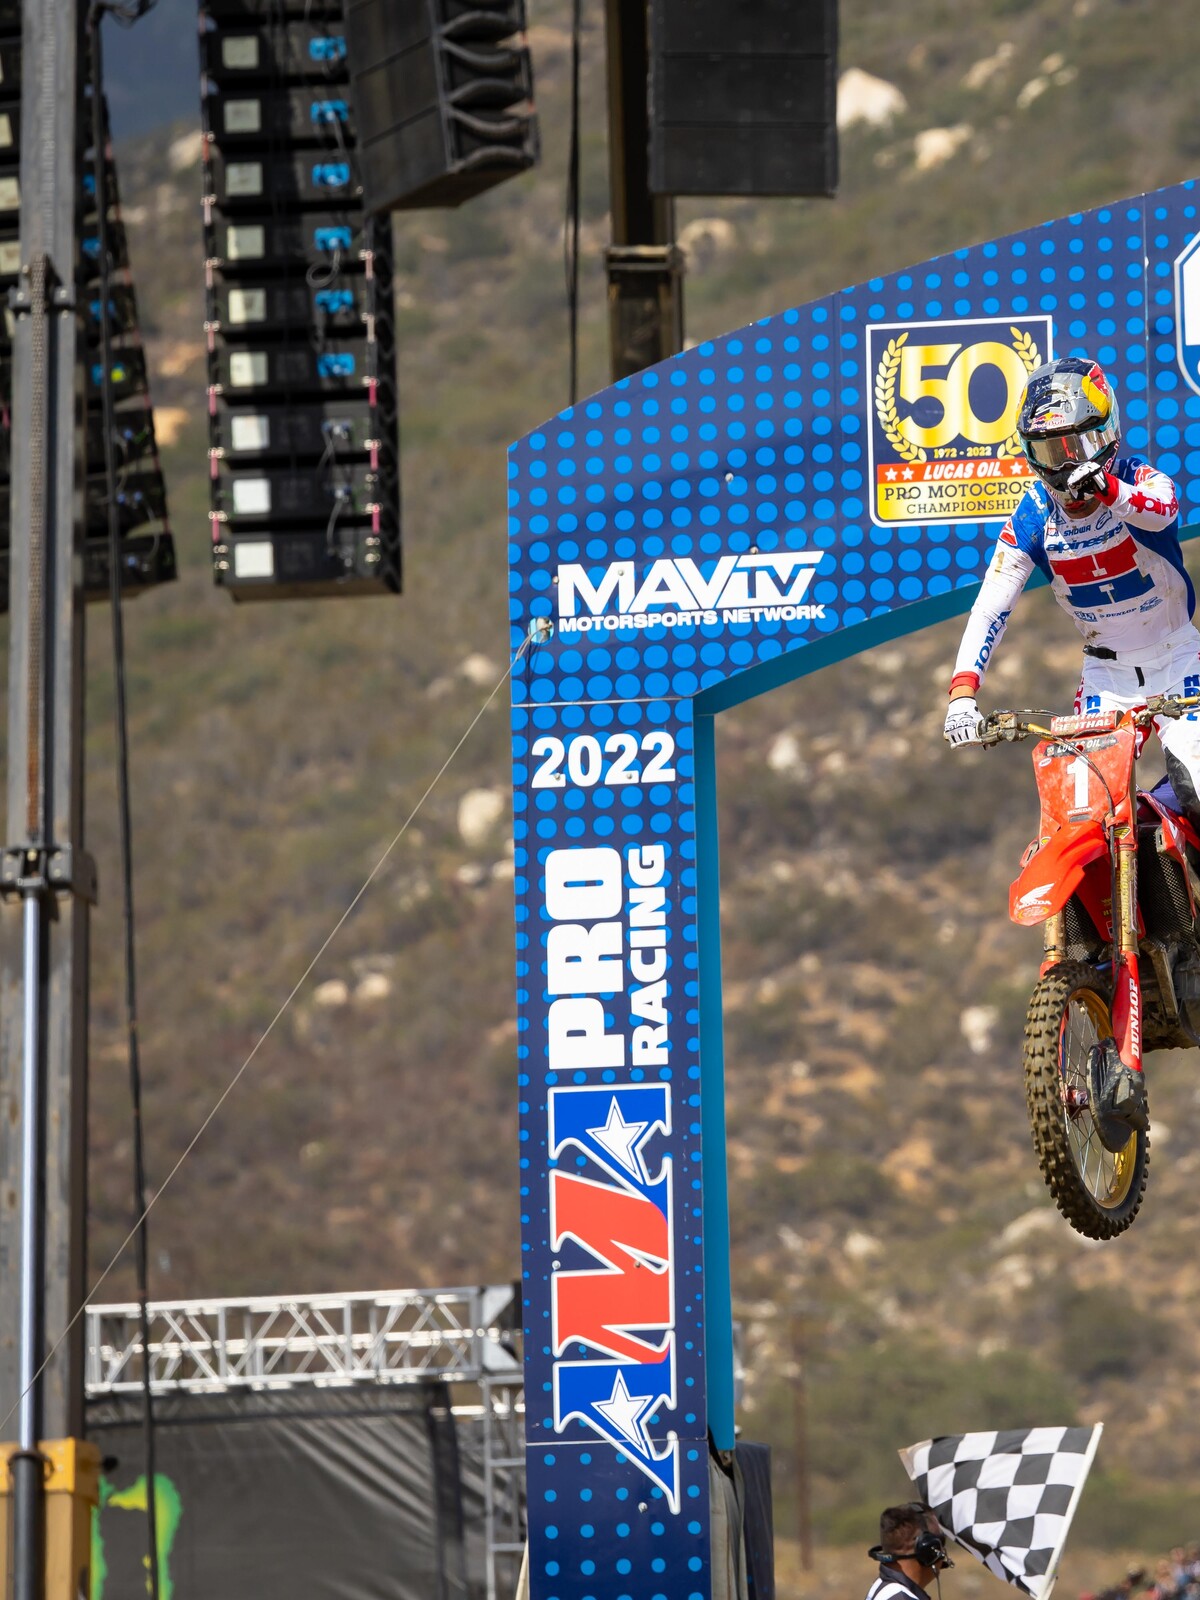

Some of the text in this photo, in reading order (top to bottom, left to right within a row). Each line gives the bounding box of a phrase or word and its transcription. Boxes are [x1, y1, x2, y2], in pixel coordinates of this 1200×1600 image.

[896, 341, 1028, 448] 50
[934, 448, 957, 459] 1972
[967, 446, 992, 457] 2022
[923, 462, 1001, 481] LUCAS OIL
[884, 486, 922, 501] PRO
[928, 480, 1040, 499] MOTOCROS
[1063, 524, 1092, 537] SHOWA
[557, 551, 824, 617] MAVTV
[558, 604, 826, 633] MOTORSPORTS NETWORK
[1105, 607, 1137, 618] DUNLOP
[1054, 719, 1112, 732] RENTHAL
[531, 731, 676, 789] 2022
[1067, 755, 1089, 809] 1
[1067, 807, 1093, 815] HONDA
[545, 847, 625, 1069] PRO
[628, 844, 669, 1066] RACING
[1129, 977, 1140, 1059] DUNLOP
